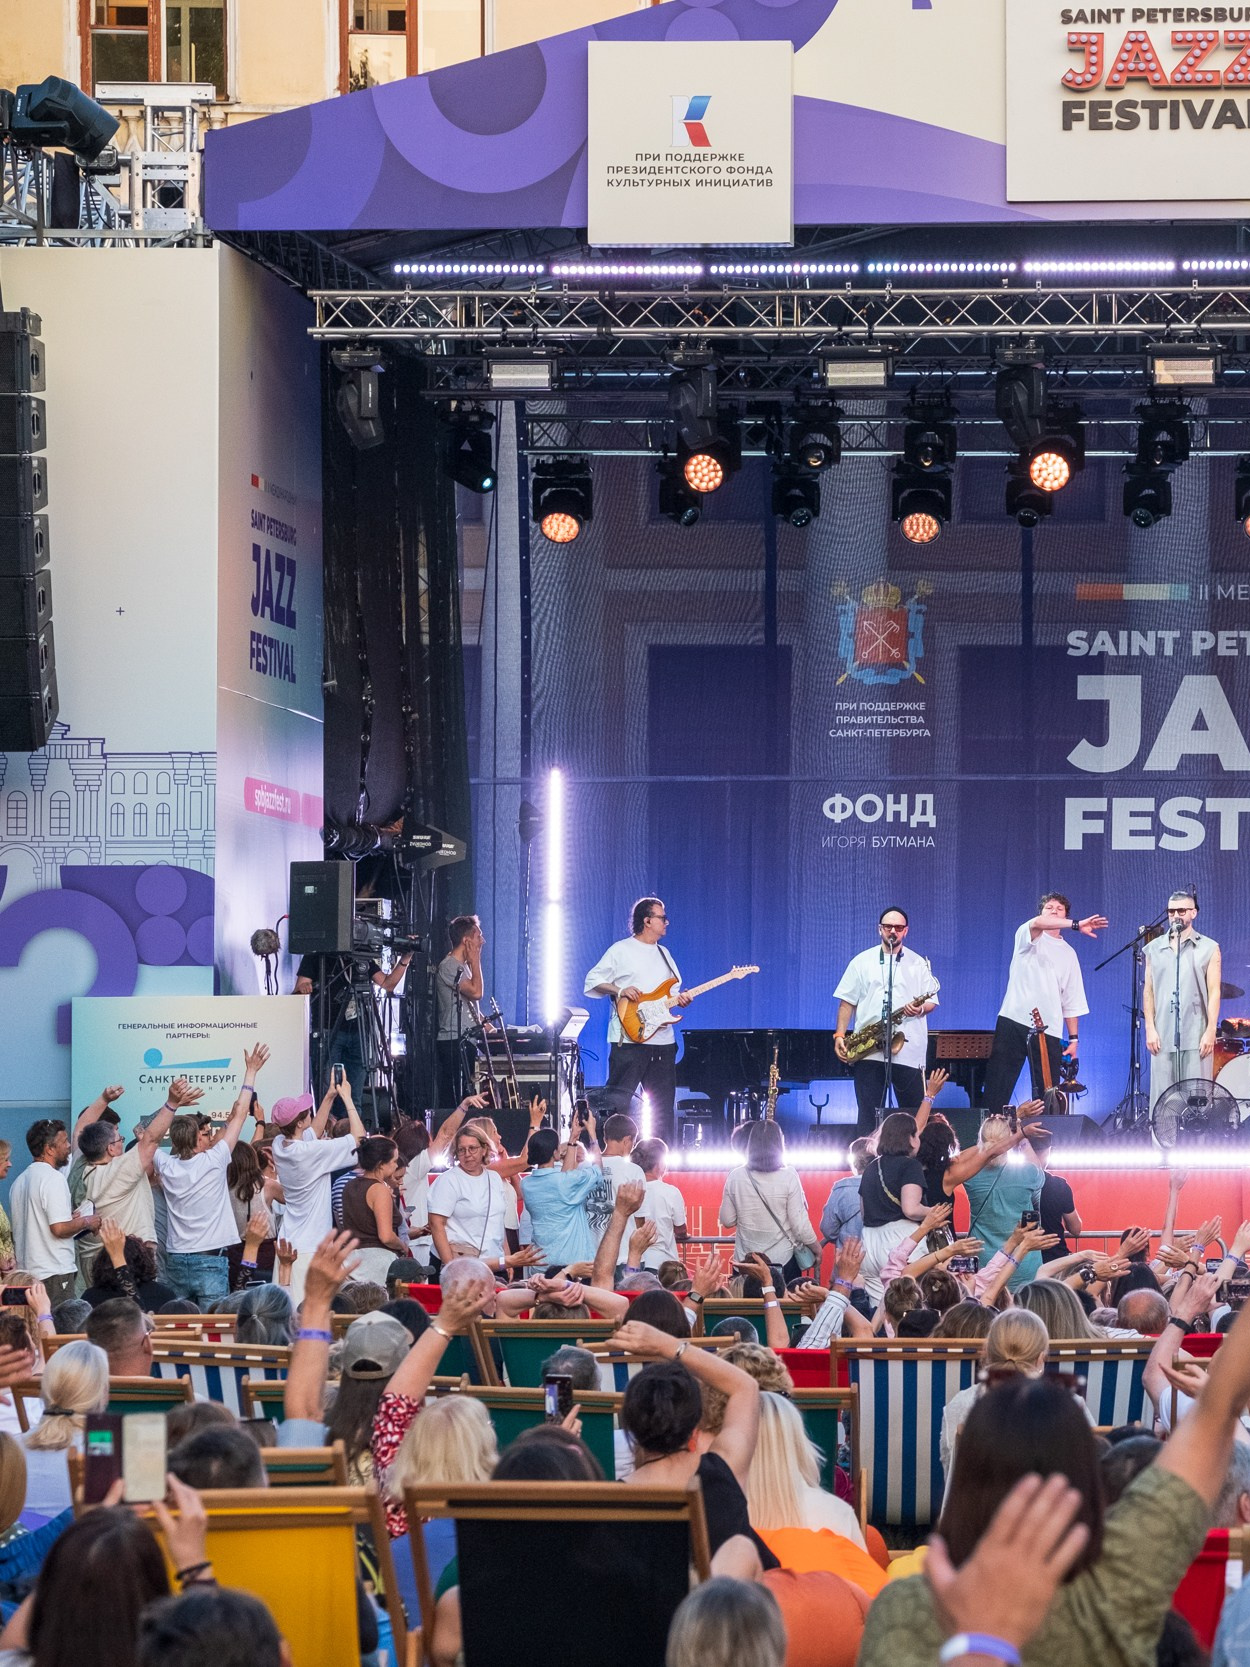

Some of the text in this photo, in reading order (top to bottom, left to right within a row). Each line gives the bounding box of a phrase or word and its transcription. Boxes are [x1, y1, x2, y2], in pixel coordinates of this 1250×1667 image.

[1060, 8, 1125, 24] SAINT
[635, 153, 745, 163] ПРИ ПОДДЕРЖКЕ
[606, 165, 774, 175] ПРЕЗИДЕНТСКОГО ФОНДА
[606, 178, 774, 189] КУЛЬТУРНЫХ ИНИЦИАТИВ
[250, 542, 296, 630] JAZZ
[1066, 629, 1180, 657] SAINT
[249, 630, 296, 684] FESTIVAL
[835, 702, 926, 712] ПРИ ПОДДЕРЖКЕ
[836, 715, 925, 724] ПРАВИТЕЛЬСТВА
[829, 729, 931, 738] САНКТ-ПЕТЕРБУРГА
[822, 793, 936, 828] ФОНД
[821, 836, 935, 848] ИГОРЯ БУТМАНА
[118, 1022, 258, 1030] ГЕНЕРАЛЬНЫЕ ИНФОРМАЦИОННЫЕ
